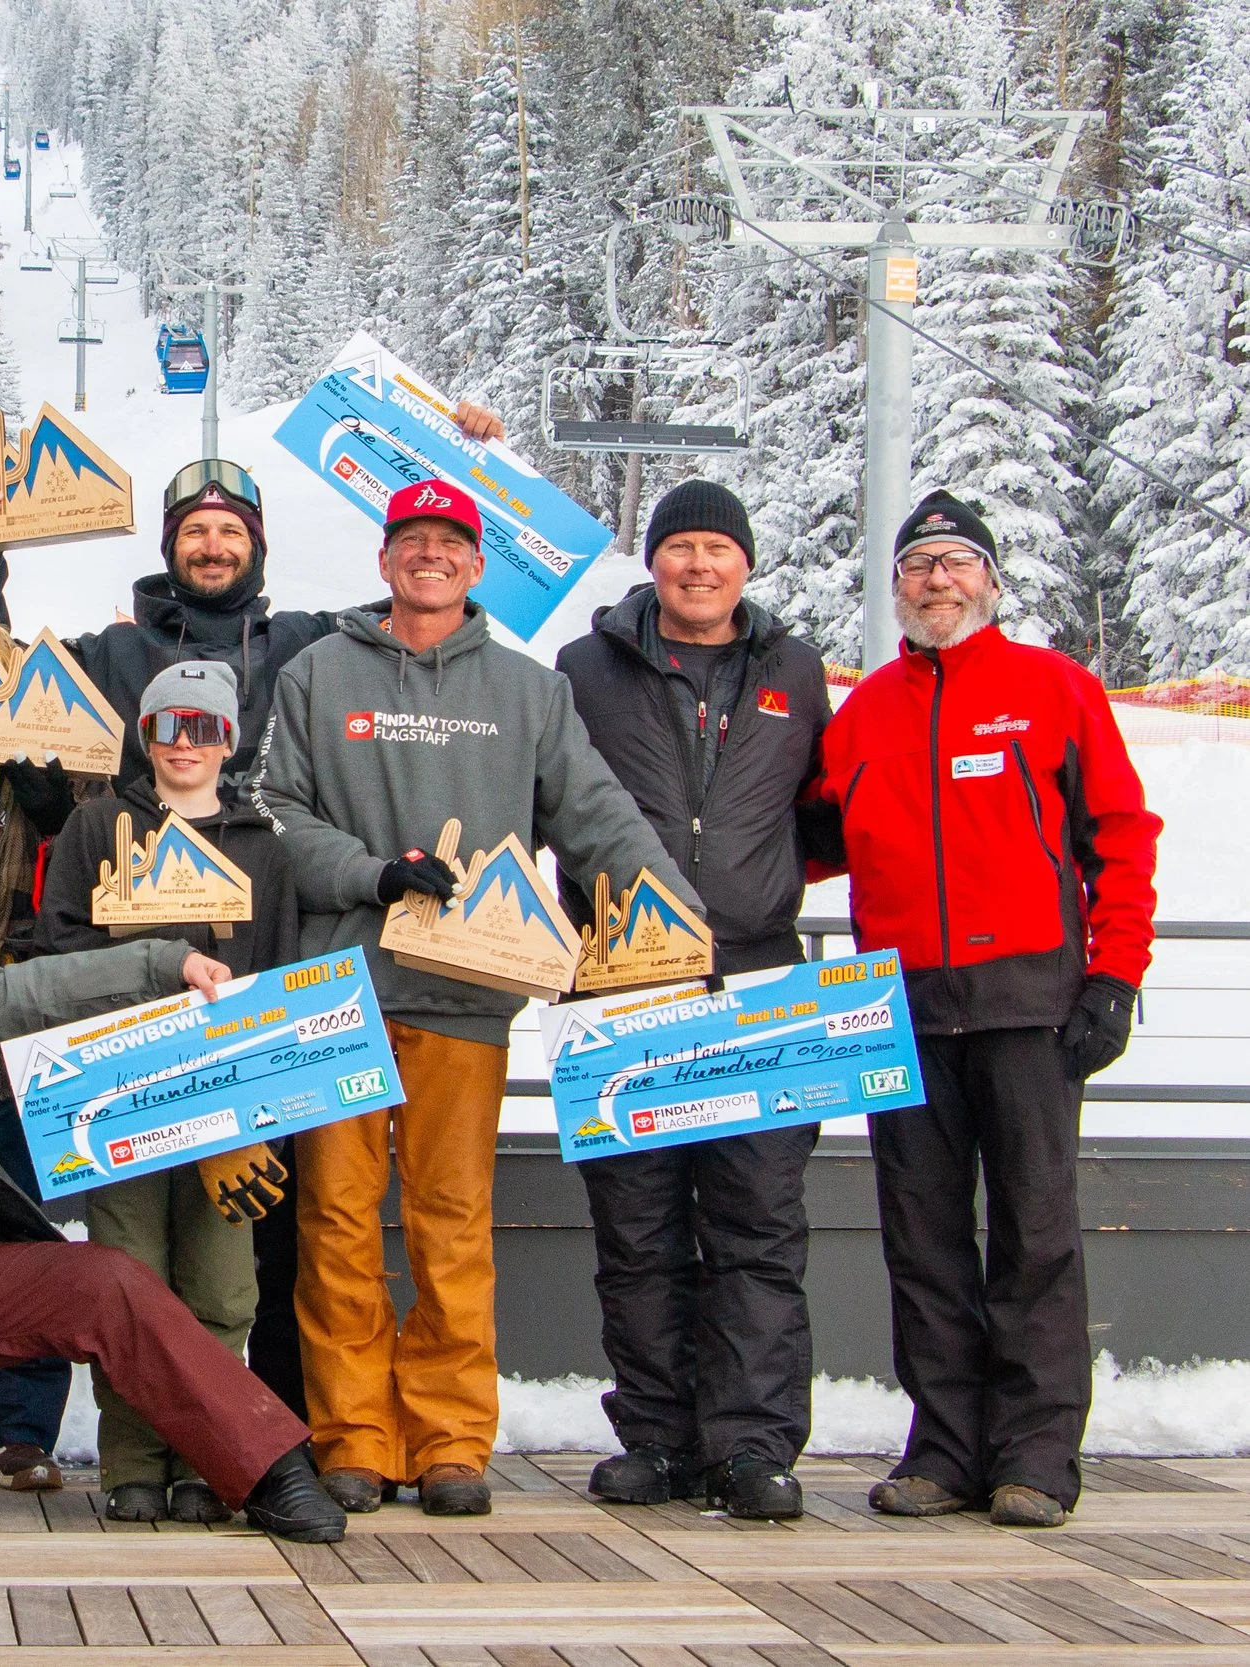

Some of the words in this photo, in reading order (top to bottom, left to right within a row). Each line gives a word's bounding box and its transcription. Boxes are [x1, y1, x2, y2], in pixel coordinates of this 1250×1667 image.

[921, 121, 928, 132] 3
[323, 381, 340, 398] Order
[340, 395, 348, 403] of
[328, 374, 341, 387] Pay
[340, 414, 376, 445] One
[387, 388, 488, 466] SNOWBOWL
[355, 468, 392, 499] FINDLA
[469, 465, 498, 491] March
[349, 476, 388, 512] FLAGSTA
[58, 506, 95, 518] LENZ
[527, 569, 551, 591] Dollars
[374, 711, 438, 730] FINDLAY
[440, 718, 499, 736] TOYOTA
[40, 742, 83, 753] LENZ
[260, 715, 277, 757] TOYOTA
[374, 726, 451, 746] FLAGSTAFF
[489, 949, 534, 965] LENZ
[650, 957, 682, 967] LENZ
[283, 962, 330, 992] 0001
[335, 957, 355, 978] st
[818, 961, 867, 987] 0002
[873, 956, 898, 978] nd
[602, 998, 650, 1018] Inaugural
[651, 994, 673, 1006] ASA
[674, 986, 710, 1001] Skibike
[736, 1009, 770, 1026] March
[773, 1005, 789, 1019] 15,
[791, 1000, 819, 1016] 2025
[68, 1022, 116, 1047] Inaugural
[117, 1015, 139, 1030] ASA
[139, 1002, 181, 1022] Skibiker
[181, 997, 191, 1008] X
[205, 1020, 239, 1040] March
[241, 1015, 257, 1030] 15,
[259, 1006, 287, 1025] 2025
[309, 1008, 361, 1035] 200.00
[612, 993, 742, 1037] SNOWBOWL
[79, 1008, 211, 1065] SNOWBOWL
[338, 1041, 369, 1055] Dollars
[865, 1042, 896, 1054] Dollars
[644, 1047, 685, 1067] Trent
[556, 1066, 570, 1076] Pay
[571, 1064, 580, 1072] to
[557, 1074, 580, 1084] Order
[581, 1072, 590, 1080] of
[598, 1074, 655, 1097] Five
[798, 1044, 862, 1059] 00/100
[55, 1107, 113, 1127] Two
[129, 1065, 240, 1108] Hundred
[270, 1046, 334, 1066] 00/100
[340, 1072, 384, 1101] LENZ
[802, 1082, 839, 1094] American
[864, 1070, 906, 1095] LENZ
[25, 1099, 40, 1109] Pay
[41, 1096, 50, 1104] to
[280, 1091, 316, 1105] American
[654, 1102, 705, 1118] FINDLAY
[709, 1094, 757, 1110] TOYOTA
[27, 1106, 51, 1118] Order
[52, 1103, 61, 1112] of
[656, 1113, 719, 1130] FLAGSTAFF
[131, 1124, 183, 1147] FINDLAY
[186, 1111, 235, 1133] TOYOTA
[134, 1133, 198, 1159] FLAGSTAFF
[573, 1135, 617, 1148] SKIBYK
[52, 1168, 97, 1187] SKIBYK
